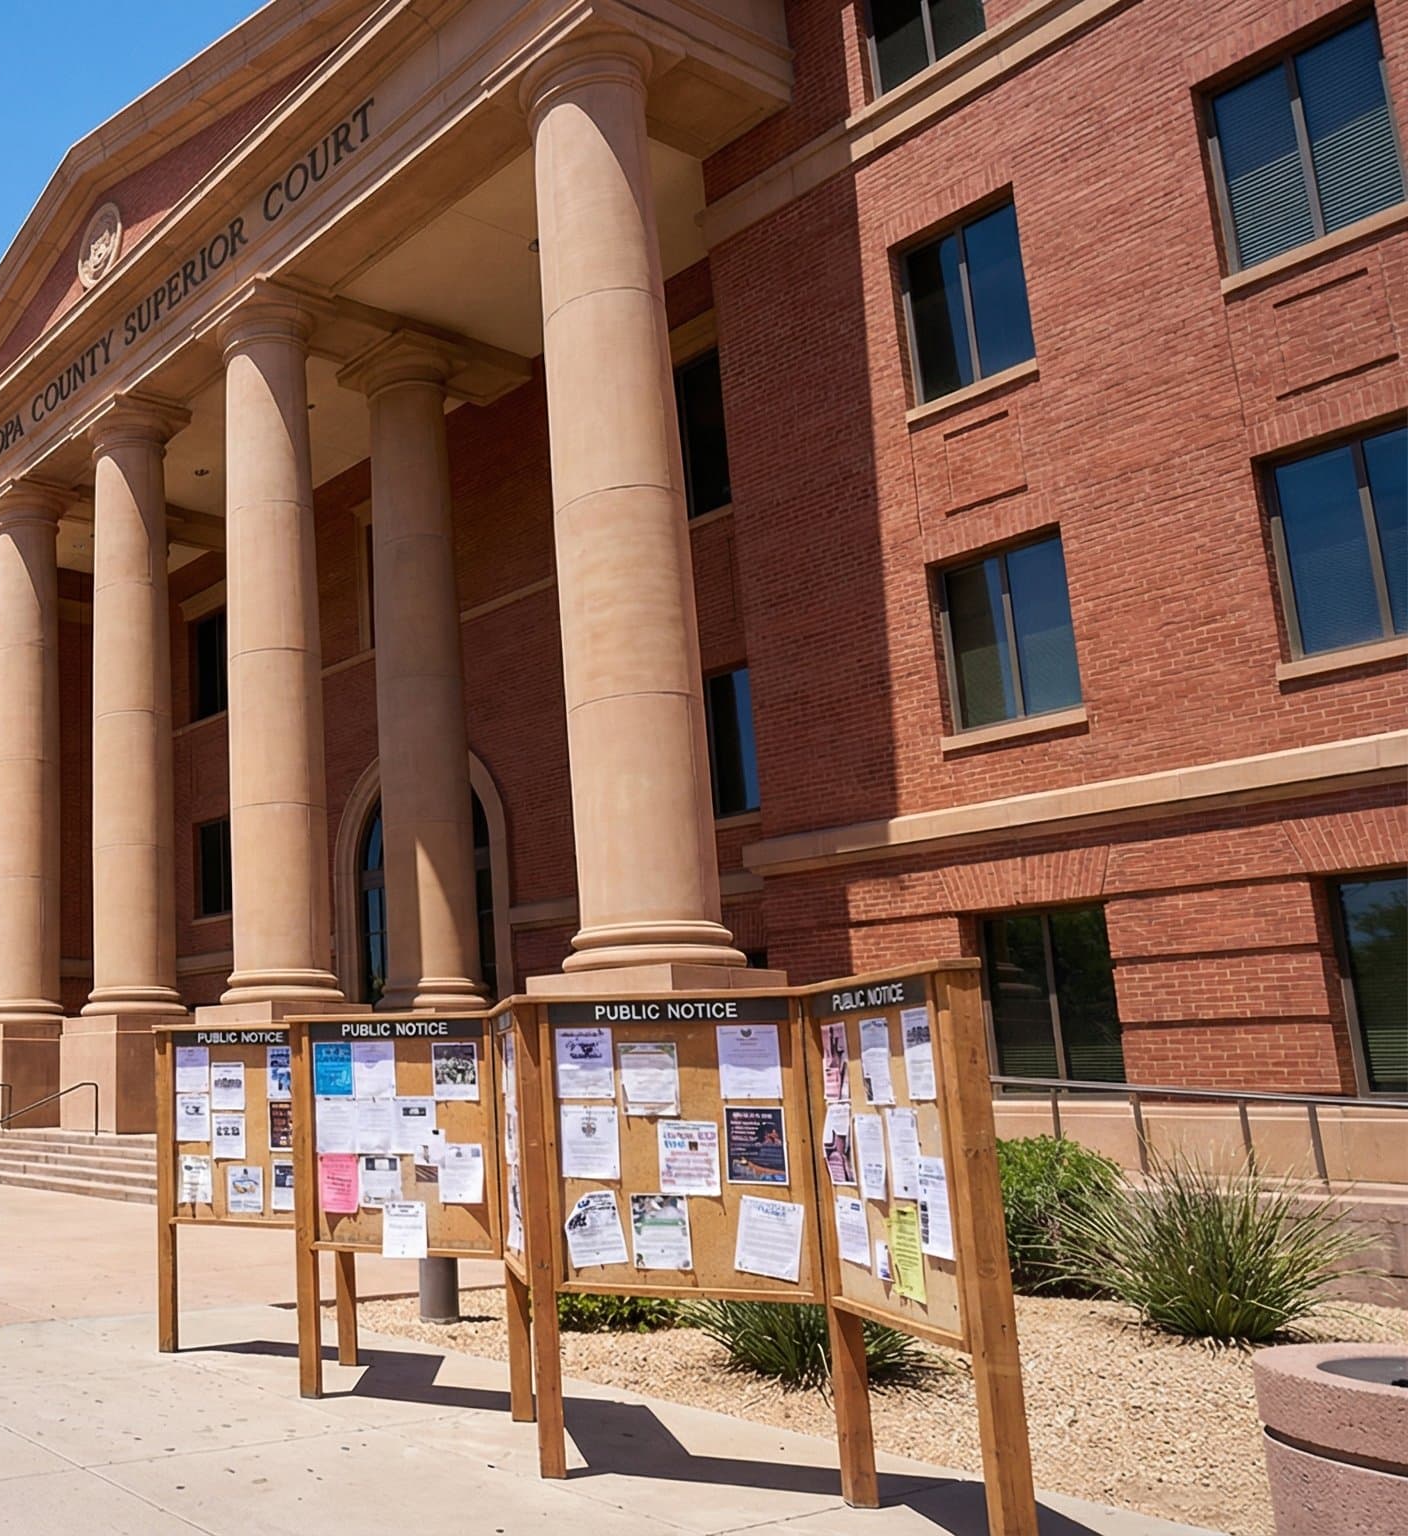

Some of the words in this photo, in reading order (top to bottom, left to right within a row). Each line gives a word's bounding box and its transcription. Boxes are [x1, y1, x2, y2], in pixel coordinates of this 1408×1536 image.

[31, 331, 118, 423] COUNTY
[123, 217, 249, 346] SUPERIOR
[263, 97, 376, 222] COURT
[867, 982, 905, 1007] NOTICE
[594, 1004, 660, 1021] PUBLIC
[667, 1002, 738, 1020] NOTICE
[197, 1032, 238, 1044] PUBLIC
[241, 1031, 284, 1043] NOTICE
[341, 1022, 391, 1037] PUBLIC
[395, 1021, 449, 1036] NOTICE
